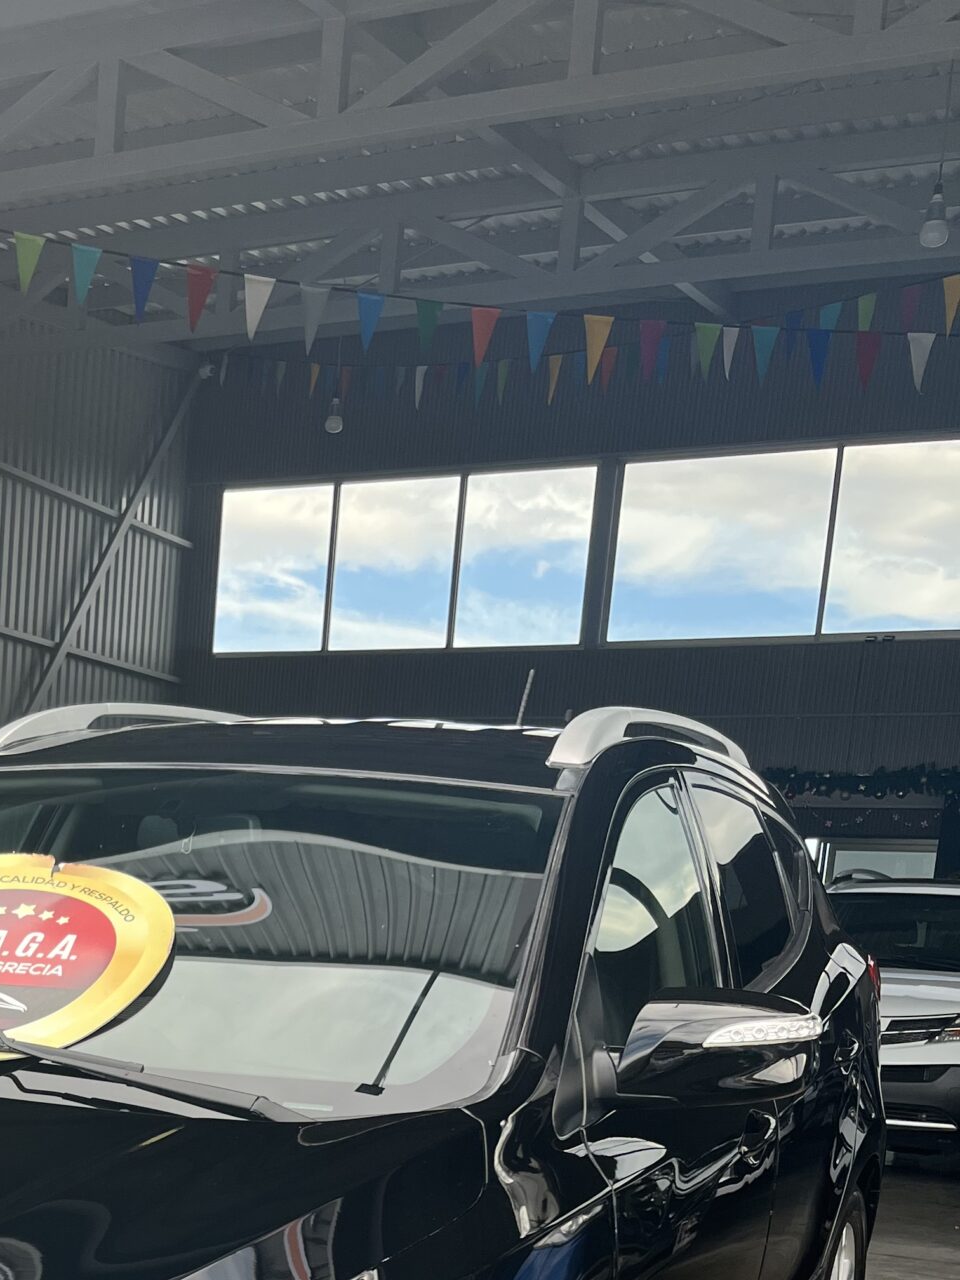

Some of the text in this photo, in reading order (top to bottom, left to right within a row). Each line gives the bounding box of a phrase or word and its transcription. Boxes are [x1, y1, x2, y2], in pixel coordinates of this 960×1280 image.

[0, 875, 68, 889] CALIDAD
[69, 883, 82, 892] Y
[80, 887, 135, 923] RESPALDO
